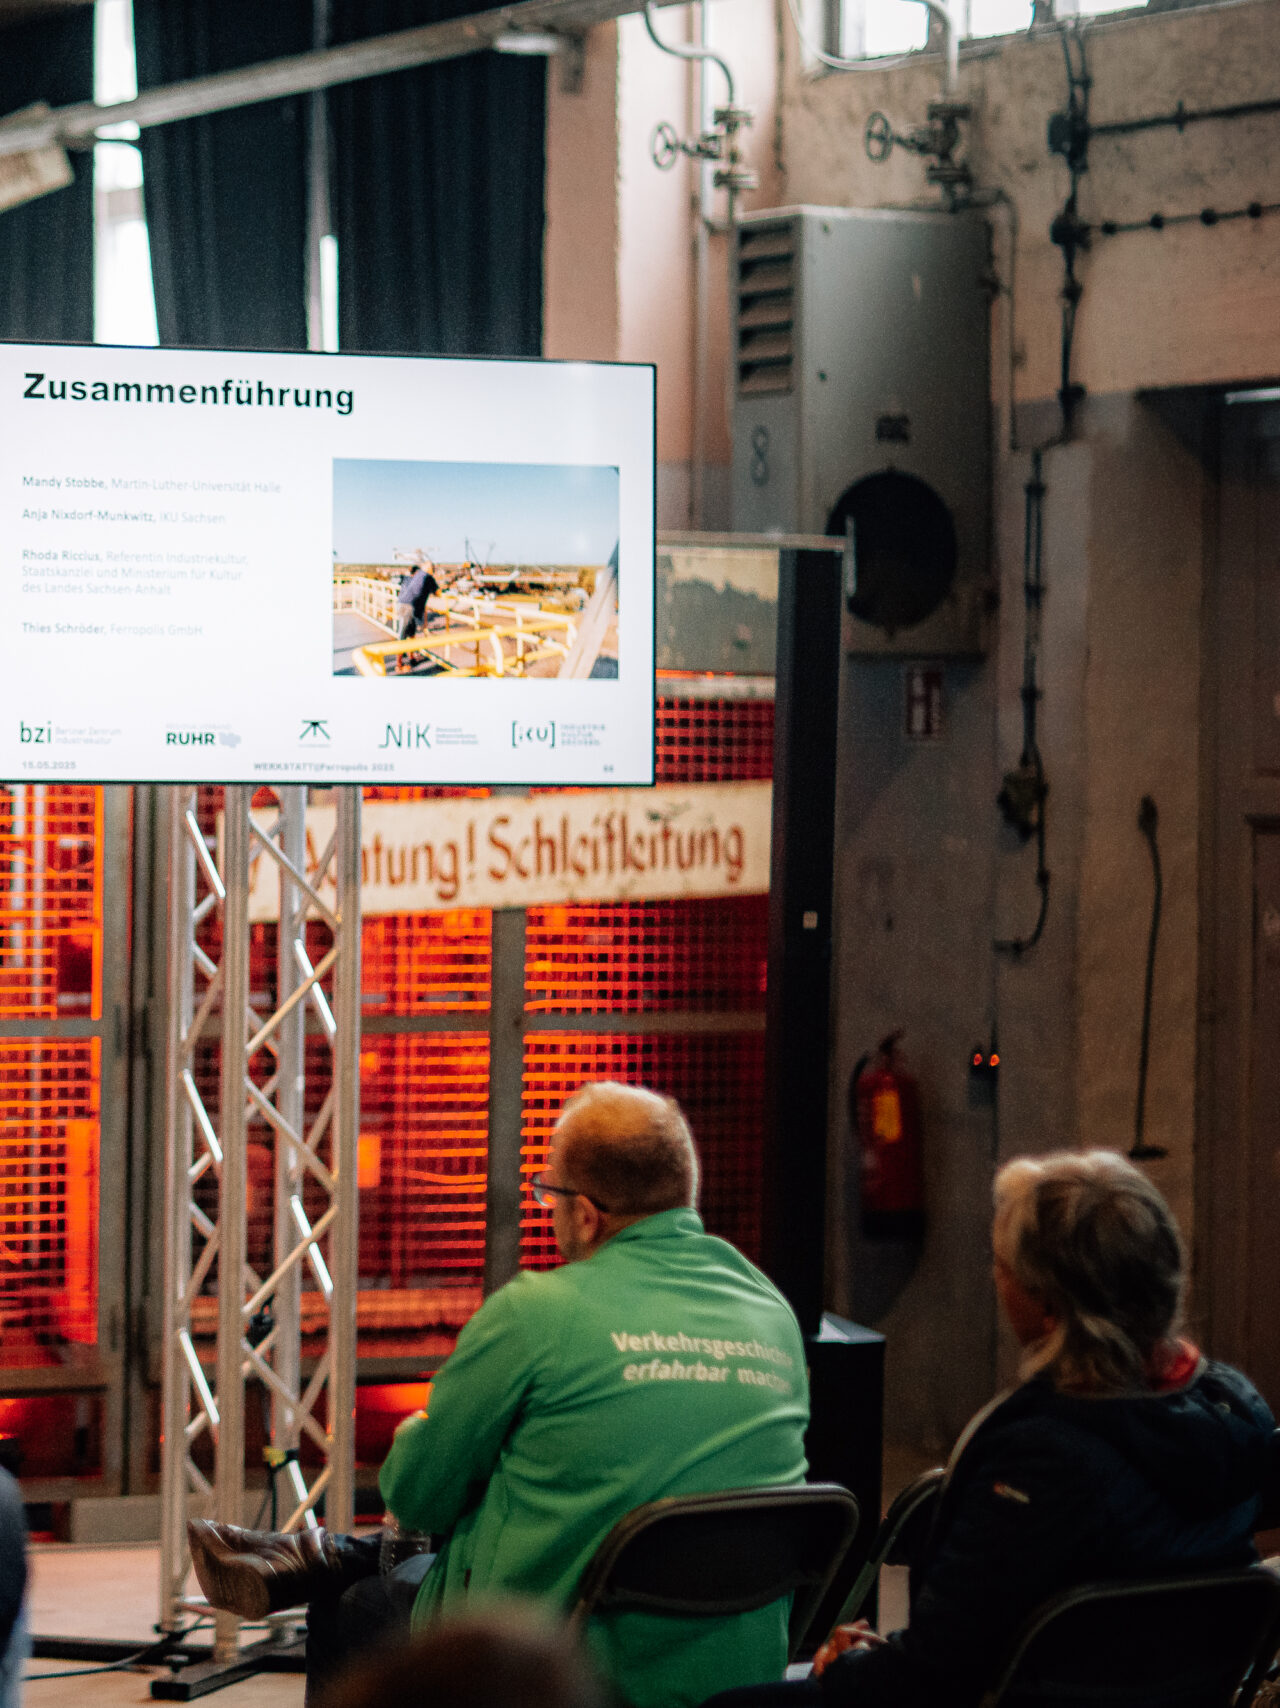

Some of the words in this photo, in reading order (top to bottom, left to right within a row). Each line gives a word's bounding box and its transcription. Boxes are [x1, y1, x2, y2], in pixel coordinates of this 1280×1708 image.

[23, 372, 354, 415] Zusammenführung
[22, 476, 62, 489] Mandy
[65, 477, 108, 490] Stobbe,
[111, 478, 251, 492] Martin-Luther-Universität
[22, 509, 47, 521] Anja
[52, 509, 156, 523] Nixdorf-Munkwitz,
[182, 512, 225, 524] Sachsen
[22, 550, 58, 561] Rhoda
[62, 550, 103, 562] Riccius,
[106, 551, 163, 563] Referentin
[22, 566, 94, 578] Staatskanzlei
[97, 567, 118, 578] und
[121, 567, 188, 580] Ministerium
[191, 568, 206, 580] für
[210, 569, 243, 581] Kultur
[22, 582, 41, 593] des
[45, 582, 83, 594] Landes
[86, 583, 171, 595] Sachsen-Anhalt
[22, 622, 52, 634] Thies
[55, 622, 107, 635] Schröder,
[110, 624, 165, 637] Ferropolis
[168, 625, 203, 636] GmbH
[20, 721, 52, 744] bzi
[166, 732, 216, 746] RUHR
[623, 1358, 730, 1383] erfahrbar
